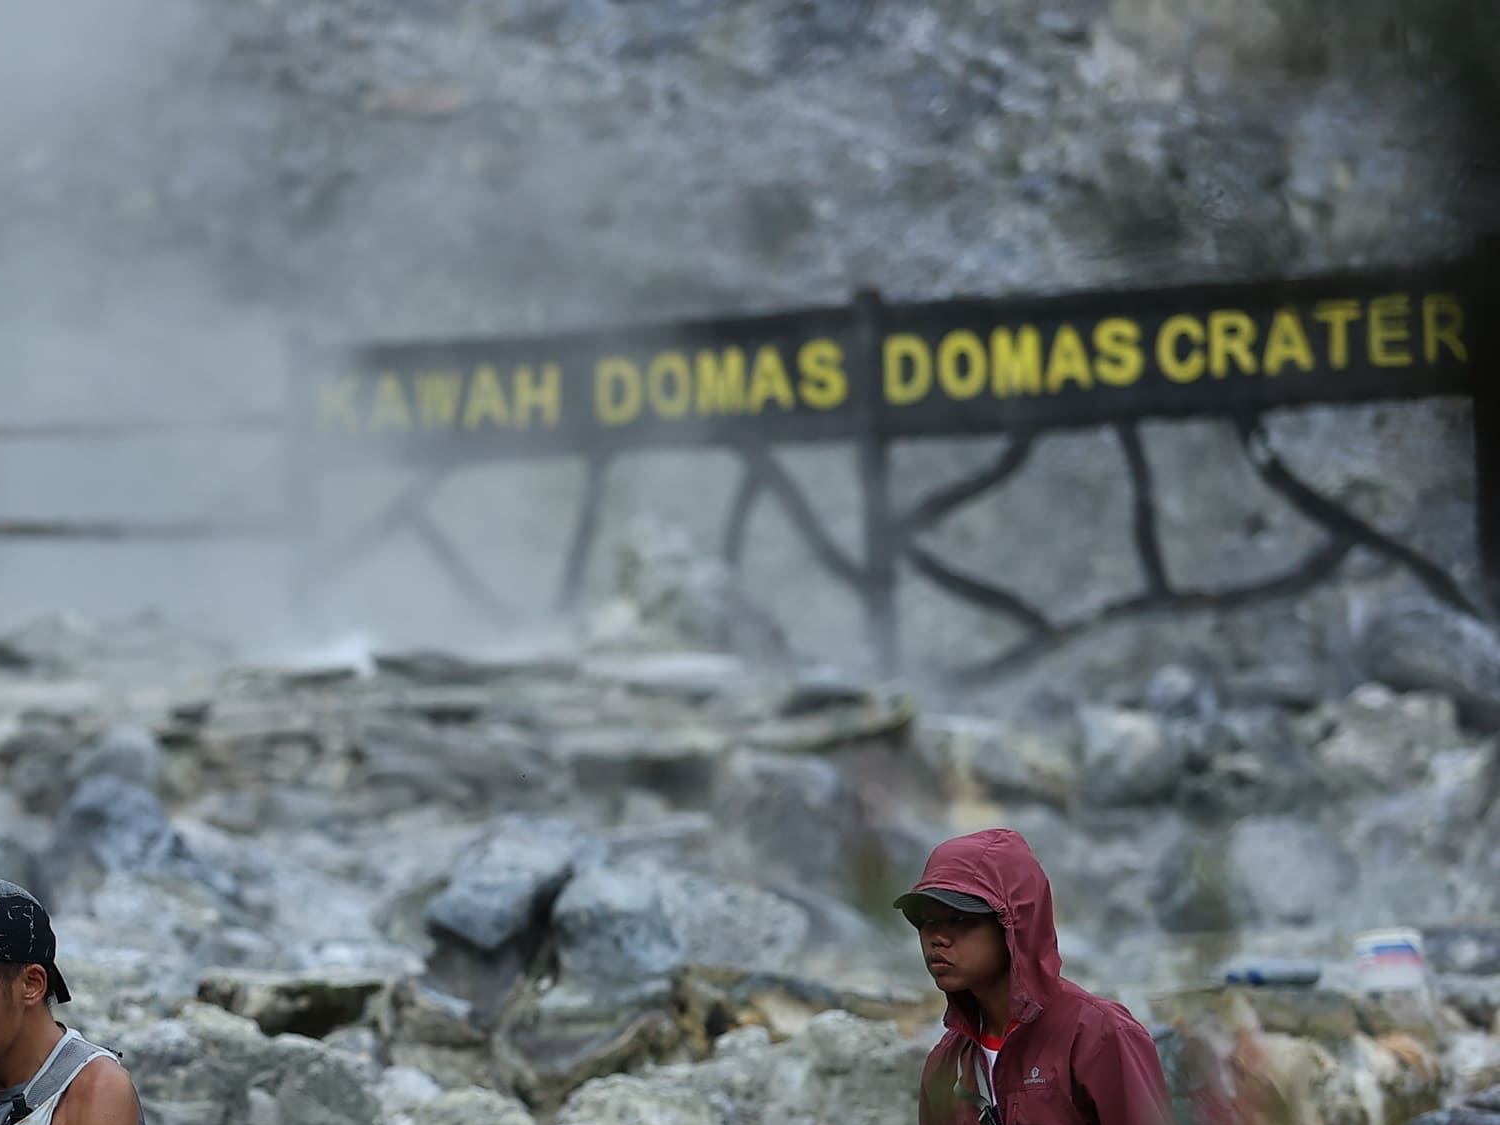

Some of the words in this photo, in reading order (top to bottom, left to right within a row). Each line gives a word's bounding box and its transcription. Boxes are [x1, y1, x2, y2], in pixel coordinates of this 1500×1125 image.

[317, 362, 563, 430] KAWAH
[594, 338, 849, 426] DOMAS
[882, 316, 1145, 404] DOMAS
[1155, 294, 1468, 383] CRATER
